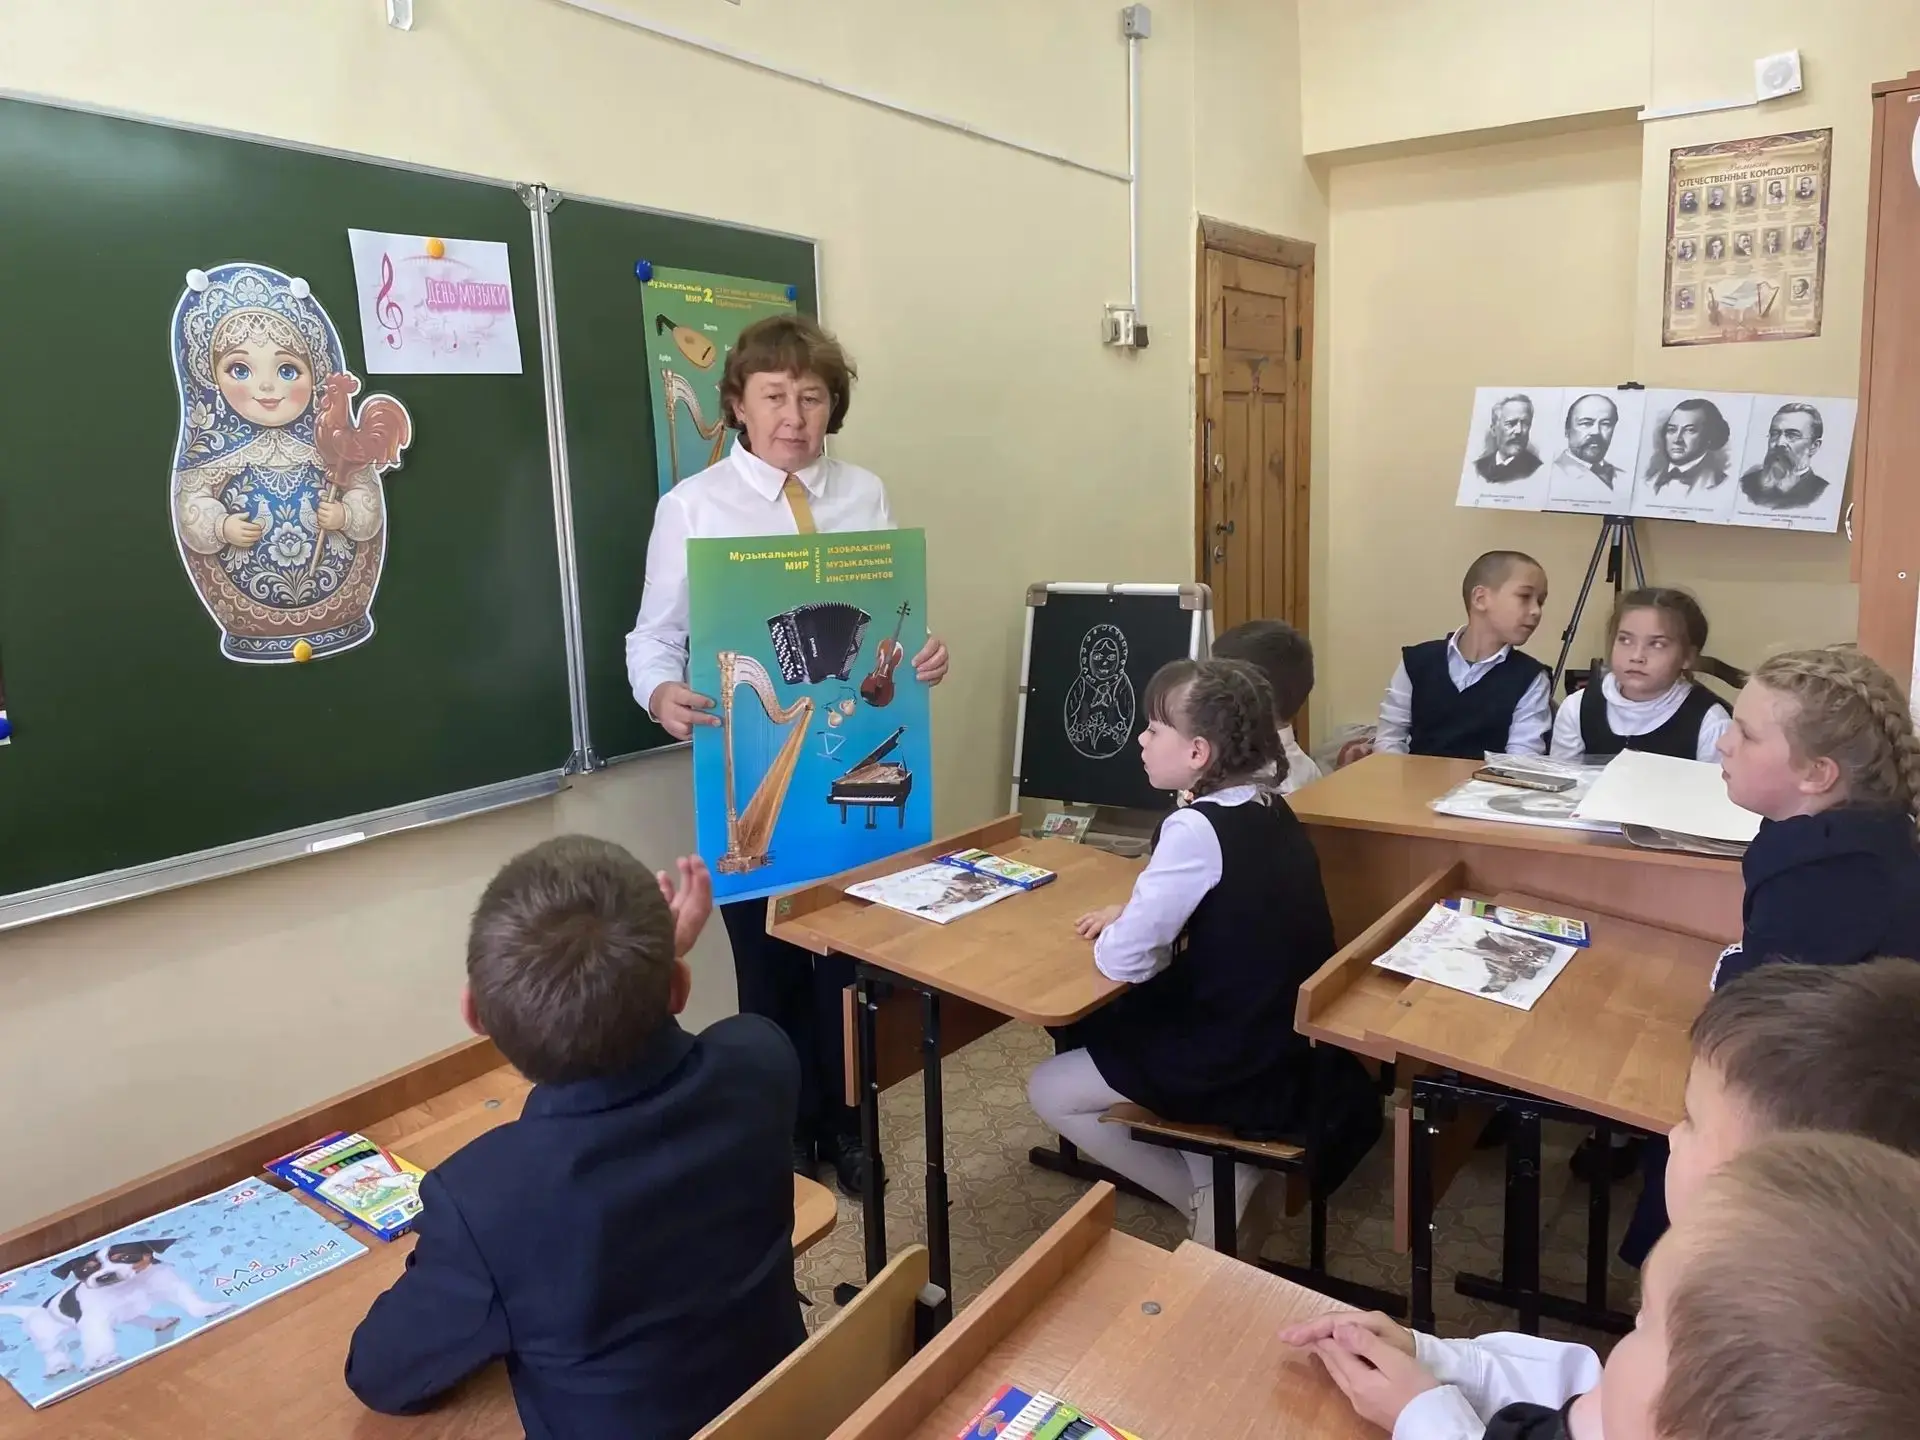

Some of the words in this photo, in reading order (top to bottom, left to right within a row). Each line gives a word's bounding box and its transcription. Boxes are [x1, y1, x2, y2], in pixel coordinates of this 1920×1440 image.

[1679, 171, 1748, 188] ОТЕЧЕСТВЕННЫЕ
[1750, 162, 1819, 179] КОМПОЗИТОРЫ
[427, 279, 456, 305] ДЕНЬ
[460, 284, 508, 306] МУЗЫКИ
[647, 280, 702, 292] Музыкальный
[703, 288, 713, 303] 2
[729, 548, 809, 562] Музыкальный
[827, 543, 891, 555] ИЗОБРАЖЕНИЯ
[784, 561, 809, 570] МИР
[826, 558, 893, 569] МУЗЫКАЛЬНЫХ
[826, 571, 893, 583] ИНСТРУМЕНТОВ
[228, 1190, 254, 1203] 20
[222, 1239, 340, 1297] РИСОВАНИЯ
